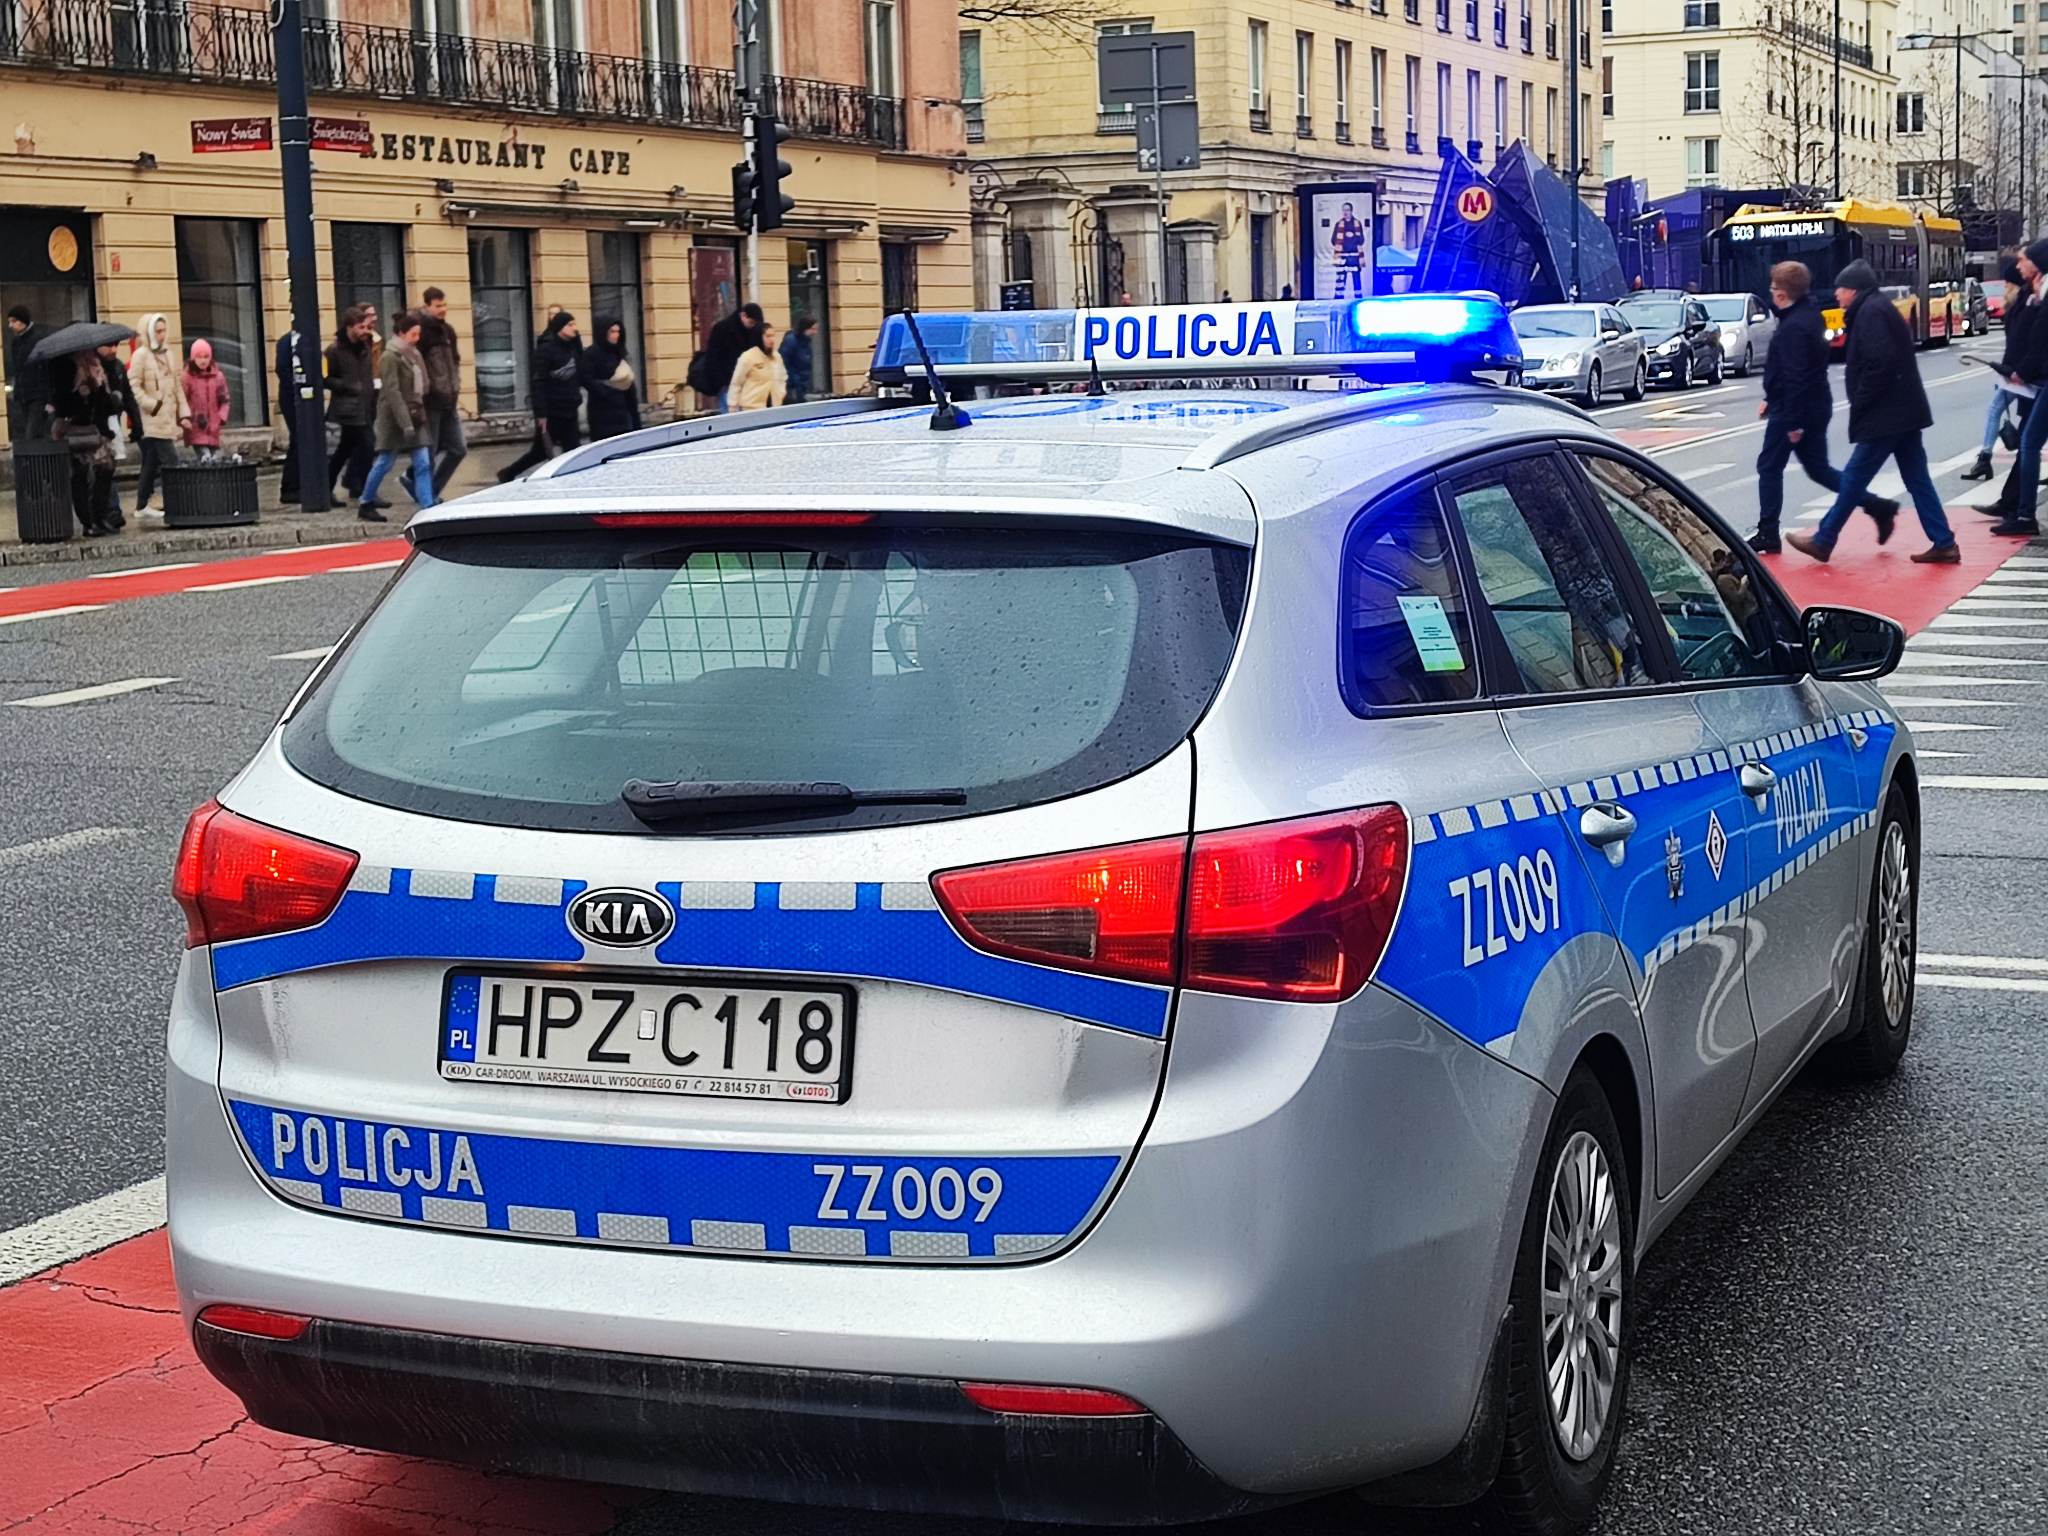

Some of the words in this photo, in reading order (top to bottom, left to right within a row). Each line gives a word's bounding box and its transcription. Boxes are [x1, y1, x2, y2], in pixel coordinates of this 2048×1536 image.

[197, 128, 229, 145] Nowy
[231, 122, 262, 141] Świat
[569, 148, 630, 176] CAFE
[1463, 191, 1488, 215] M
[1732, 225, 1755, 241] 503
[1083, 311, 1282, 360] POLICJA
[1773, 759, 1829, 855] POLICJA
[585, 901, 654, 935] KIA
[1448, 848, 1560, 968] ZZ009
[450, 1029, 472, 1050] PL
[488, 984, 635, 1064] HPZ
[661, 993, 833, 1074] C118
[449, 1066, 468, 1076] KIA
[537, 1072, 590, 1085] WARSZAWA
[609, 1076, 672, 1089] WYSOCKIEGO
[675, 1079, 688, 1090] 67
[709, 1081, 721, 1092] 22
[724, 1083, 742, 1094] 814
[744, 1084, 757, 1095] 57
[759, 1084, 771, 1095] 81
[803, 1086, 829, 1097] LOTOS
[271, 1112, 484, 1196] POLICJA
[813, 1164, 1003, 1223] ZZ009
